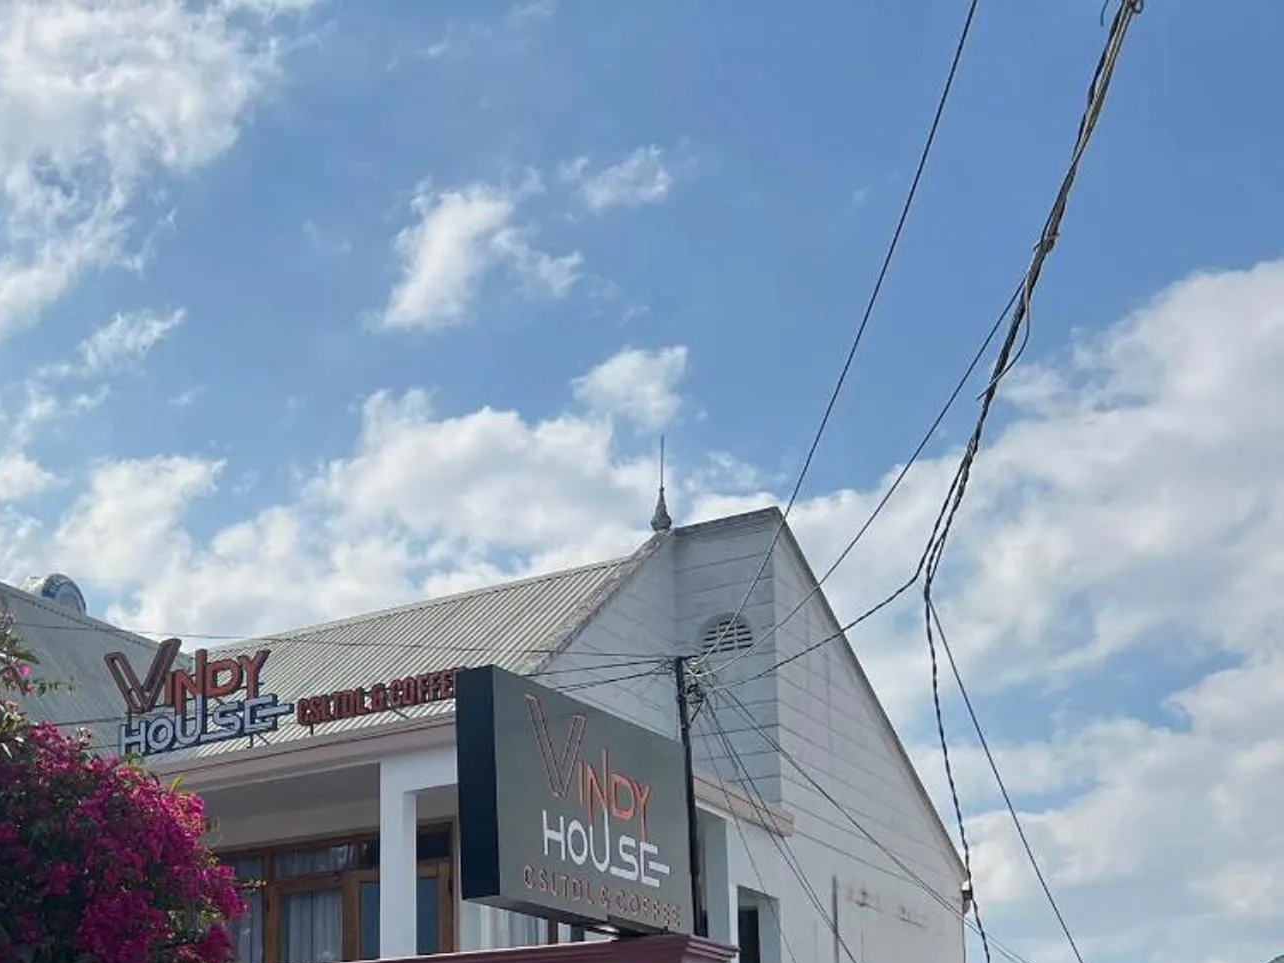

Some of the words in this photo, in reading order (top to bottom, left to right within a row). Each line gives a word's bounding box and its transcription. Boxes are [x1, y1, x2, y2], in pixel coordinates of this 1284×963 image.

[104, 638, 271, 715] VINDY
[390, 669, 456, 707] COFFE
[120, 693, 294, 756] HOUSE
[525, 693, 652, 843] VINDY
[542, 809, 670, 888] HOUSE
